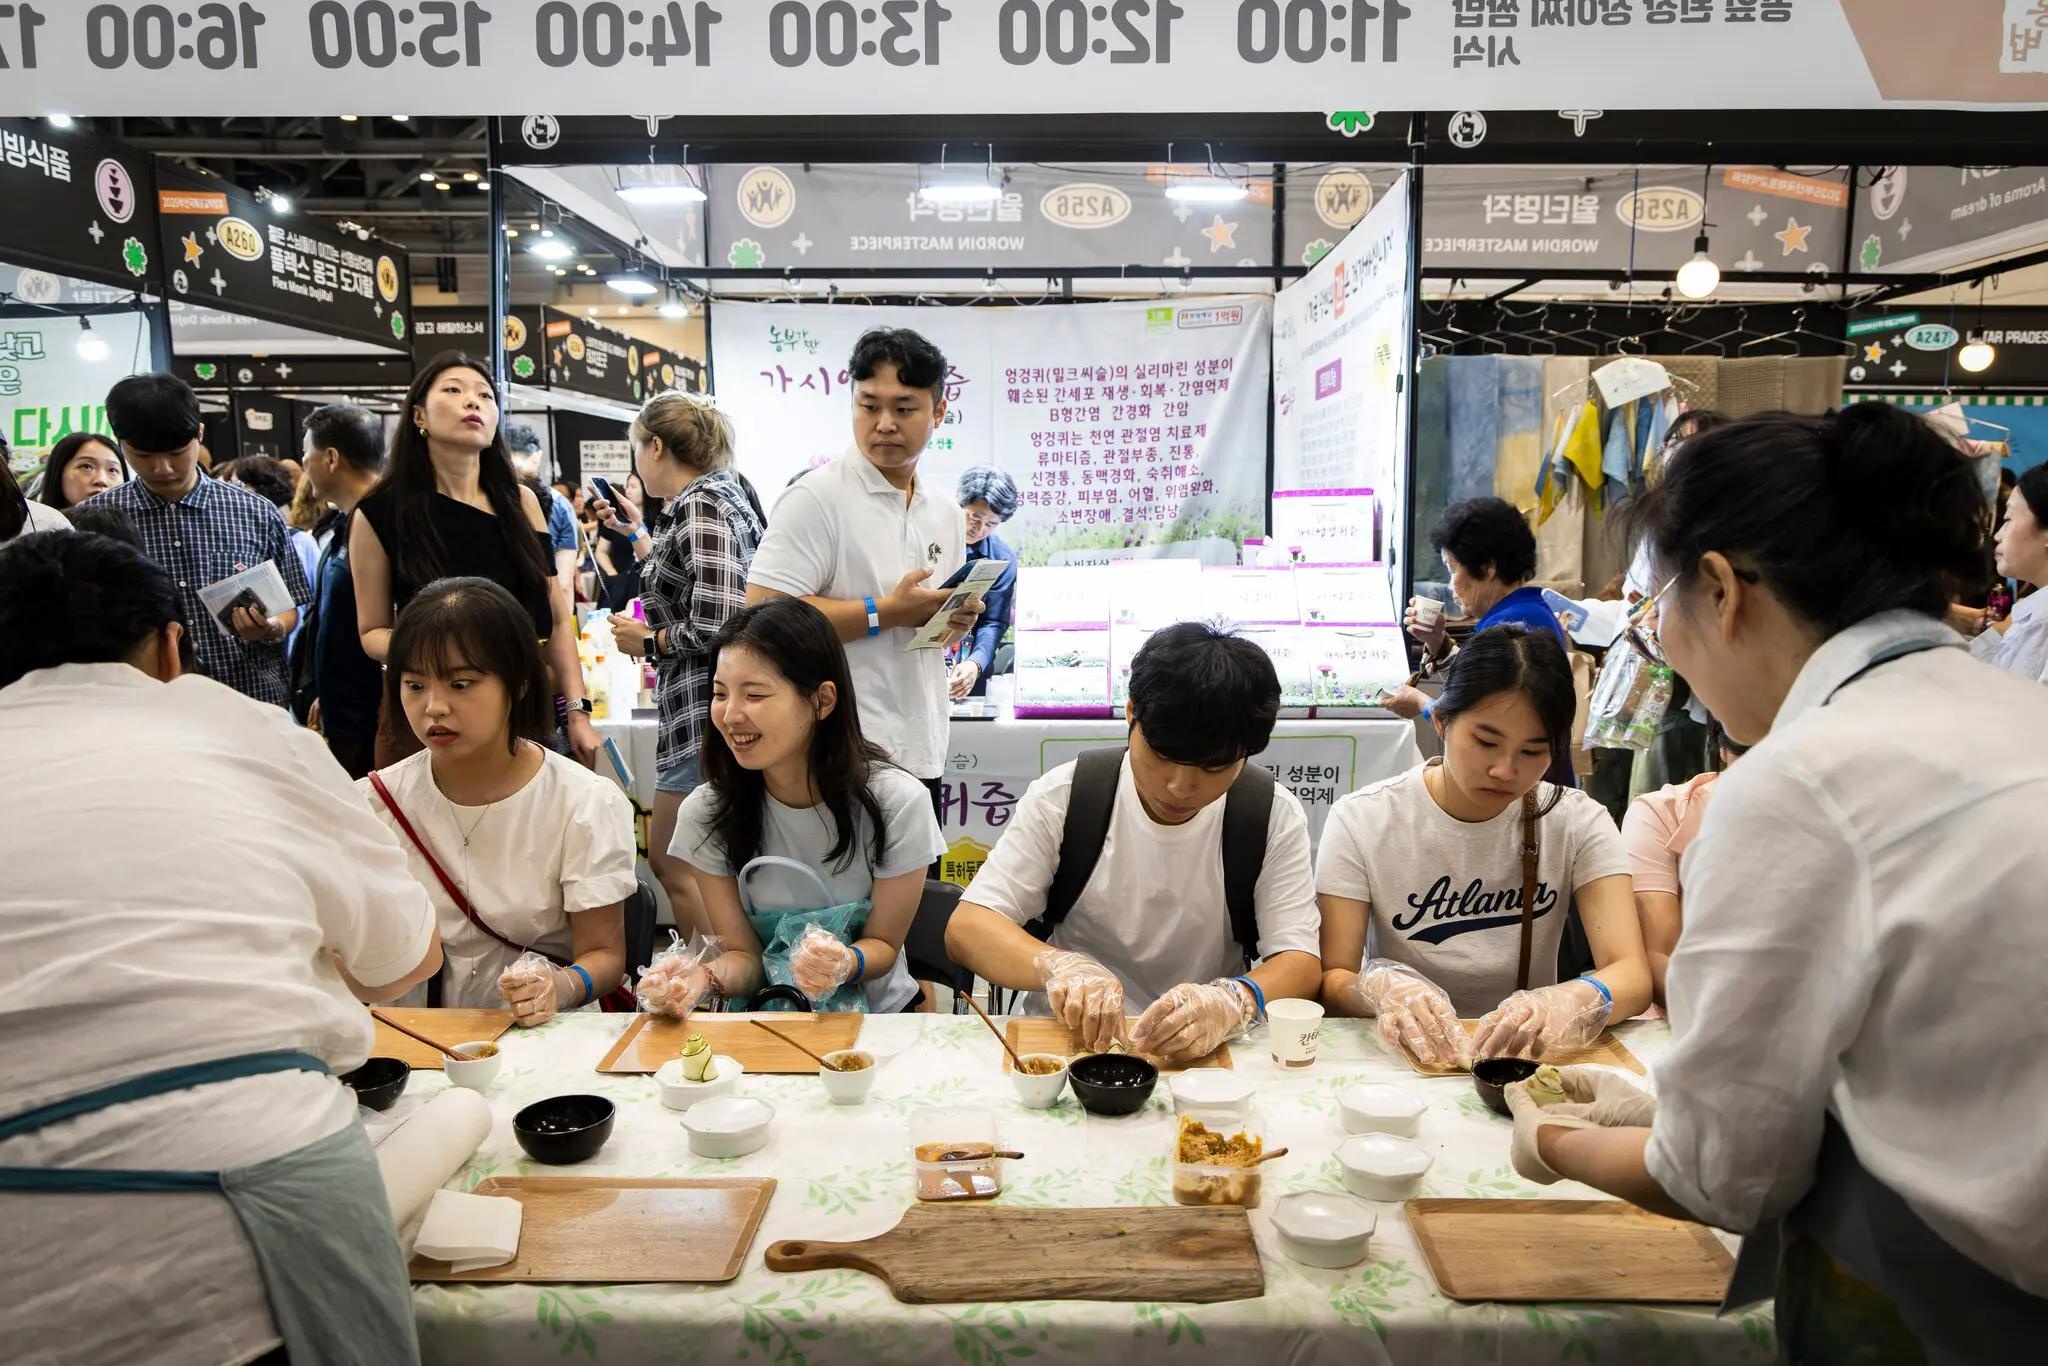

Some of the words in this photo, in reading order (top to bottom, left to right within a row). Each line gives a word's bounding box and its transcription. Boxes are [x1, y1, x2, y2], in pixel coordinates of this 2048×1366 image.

[0, 130, 71, 183] 빙식품
[226, 226, 255, 253] A260
[270, 245, 311, 281] 플렉스
[312, 258, 339, 289] 몽크
[1915, 331, 1948, 344] A247
[1005, 366, 1128, 384] 엉겅퀴(밀크씨슬)의
[1134, 361, 1188, 379] 실리마린
[1194, 357, 1234, 376] 성분이
[1055, 387, 1096, 402] 간세포
[1050, 406, 1101, 422] B형간염
[1112, 404, 1151, 421] 간경화
[1163, 401, 1189, 418] 간암
[1031, 430, 1083, 447] 엉겅퀴는
[1089, 429, 1115, 446] 천연
[1121, 427, 1161, 443] 관절염
[1167, 423, 1207, 440] 치료제
[1038, 451, 1097, 467] 류마티즘,
[1103, 447, 1163, 464] 관절부종,
[1031, 471, 1075, 487] 신경통,
[1081, 468, 1141, 485] 동맥경화,
[1147, 465, 1204, 482] 숙취해소,
[1078, 488, 1123, 504] 피부염,
[1128, 486, 1159, 501] 어혈,
[1165, 479, 1219, 497] 위염완화,
[1057, 508, 1117, 525] 소변장애,
[1287, 765, 1340, 784] 성분이
